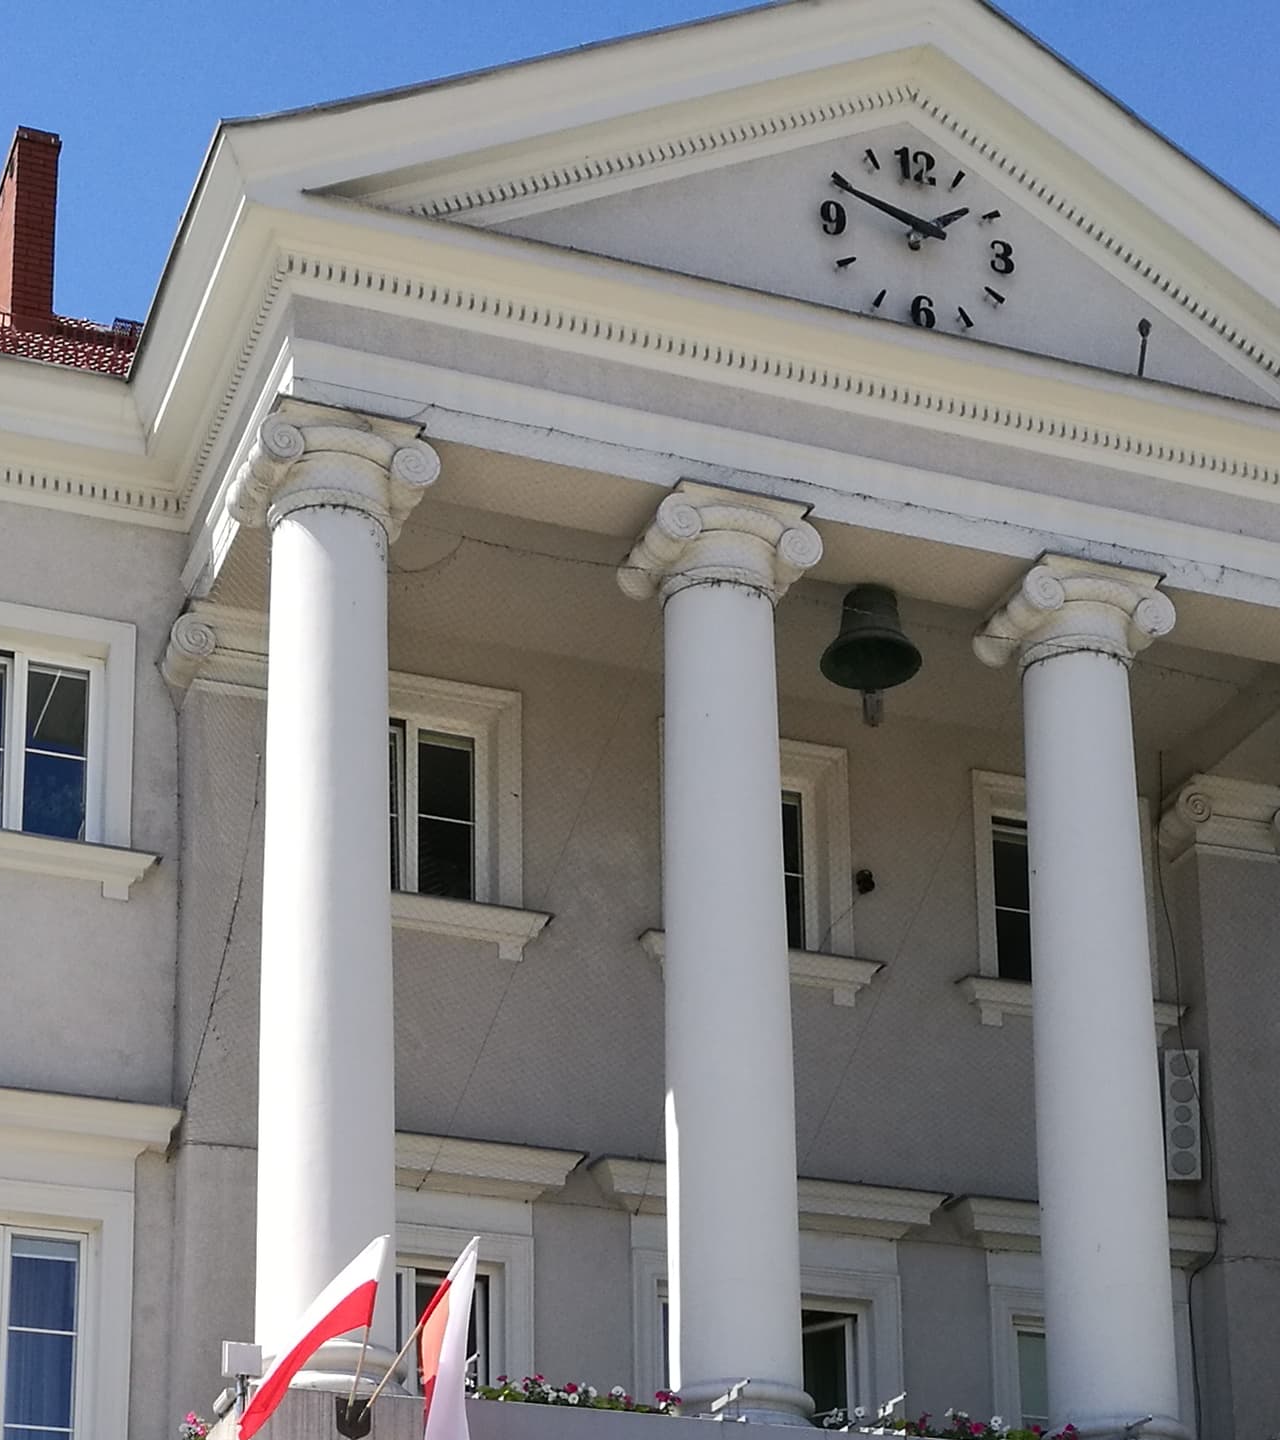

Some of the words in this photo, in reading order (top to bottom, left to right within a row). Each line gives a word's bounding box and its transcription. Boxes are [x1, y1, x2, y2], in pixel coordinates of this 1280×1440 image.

[894, 146, 936, 186] 12
[820, 200, 846, 235] 9
[990, 240, 1015, 274] 3
[910, 295, 936, 329] 6
